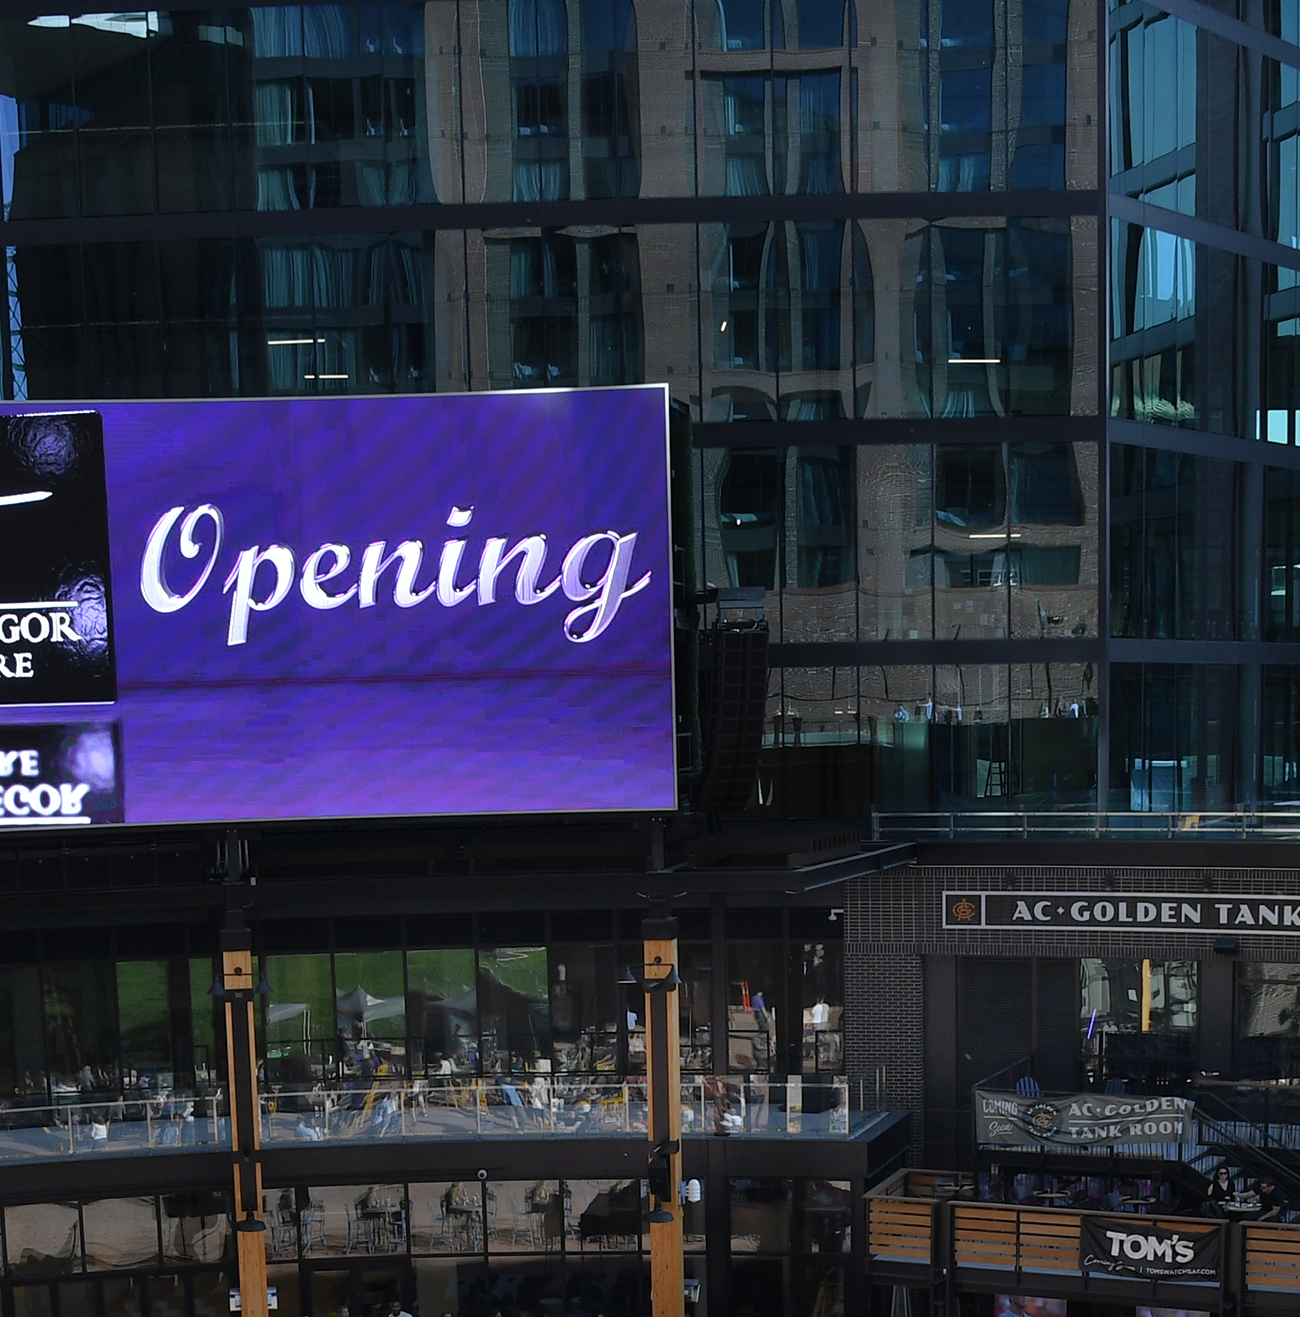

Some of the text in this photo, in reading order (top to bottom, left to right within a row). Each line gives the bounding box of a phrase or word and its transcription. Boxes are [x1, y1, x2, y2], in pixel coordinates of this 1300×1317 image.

[140, 503, 652, 646] Opening
[1011, 899, 1052, 921] AC
[1070, 900, 1202, 924] GOLDEN
[982, 1099, 1018, 1116] COMING
[1068, 1123, 1122, 1139] TANK
[1105, 1231, 1195, 1264] TOM'S
